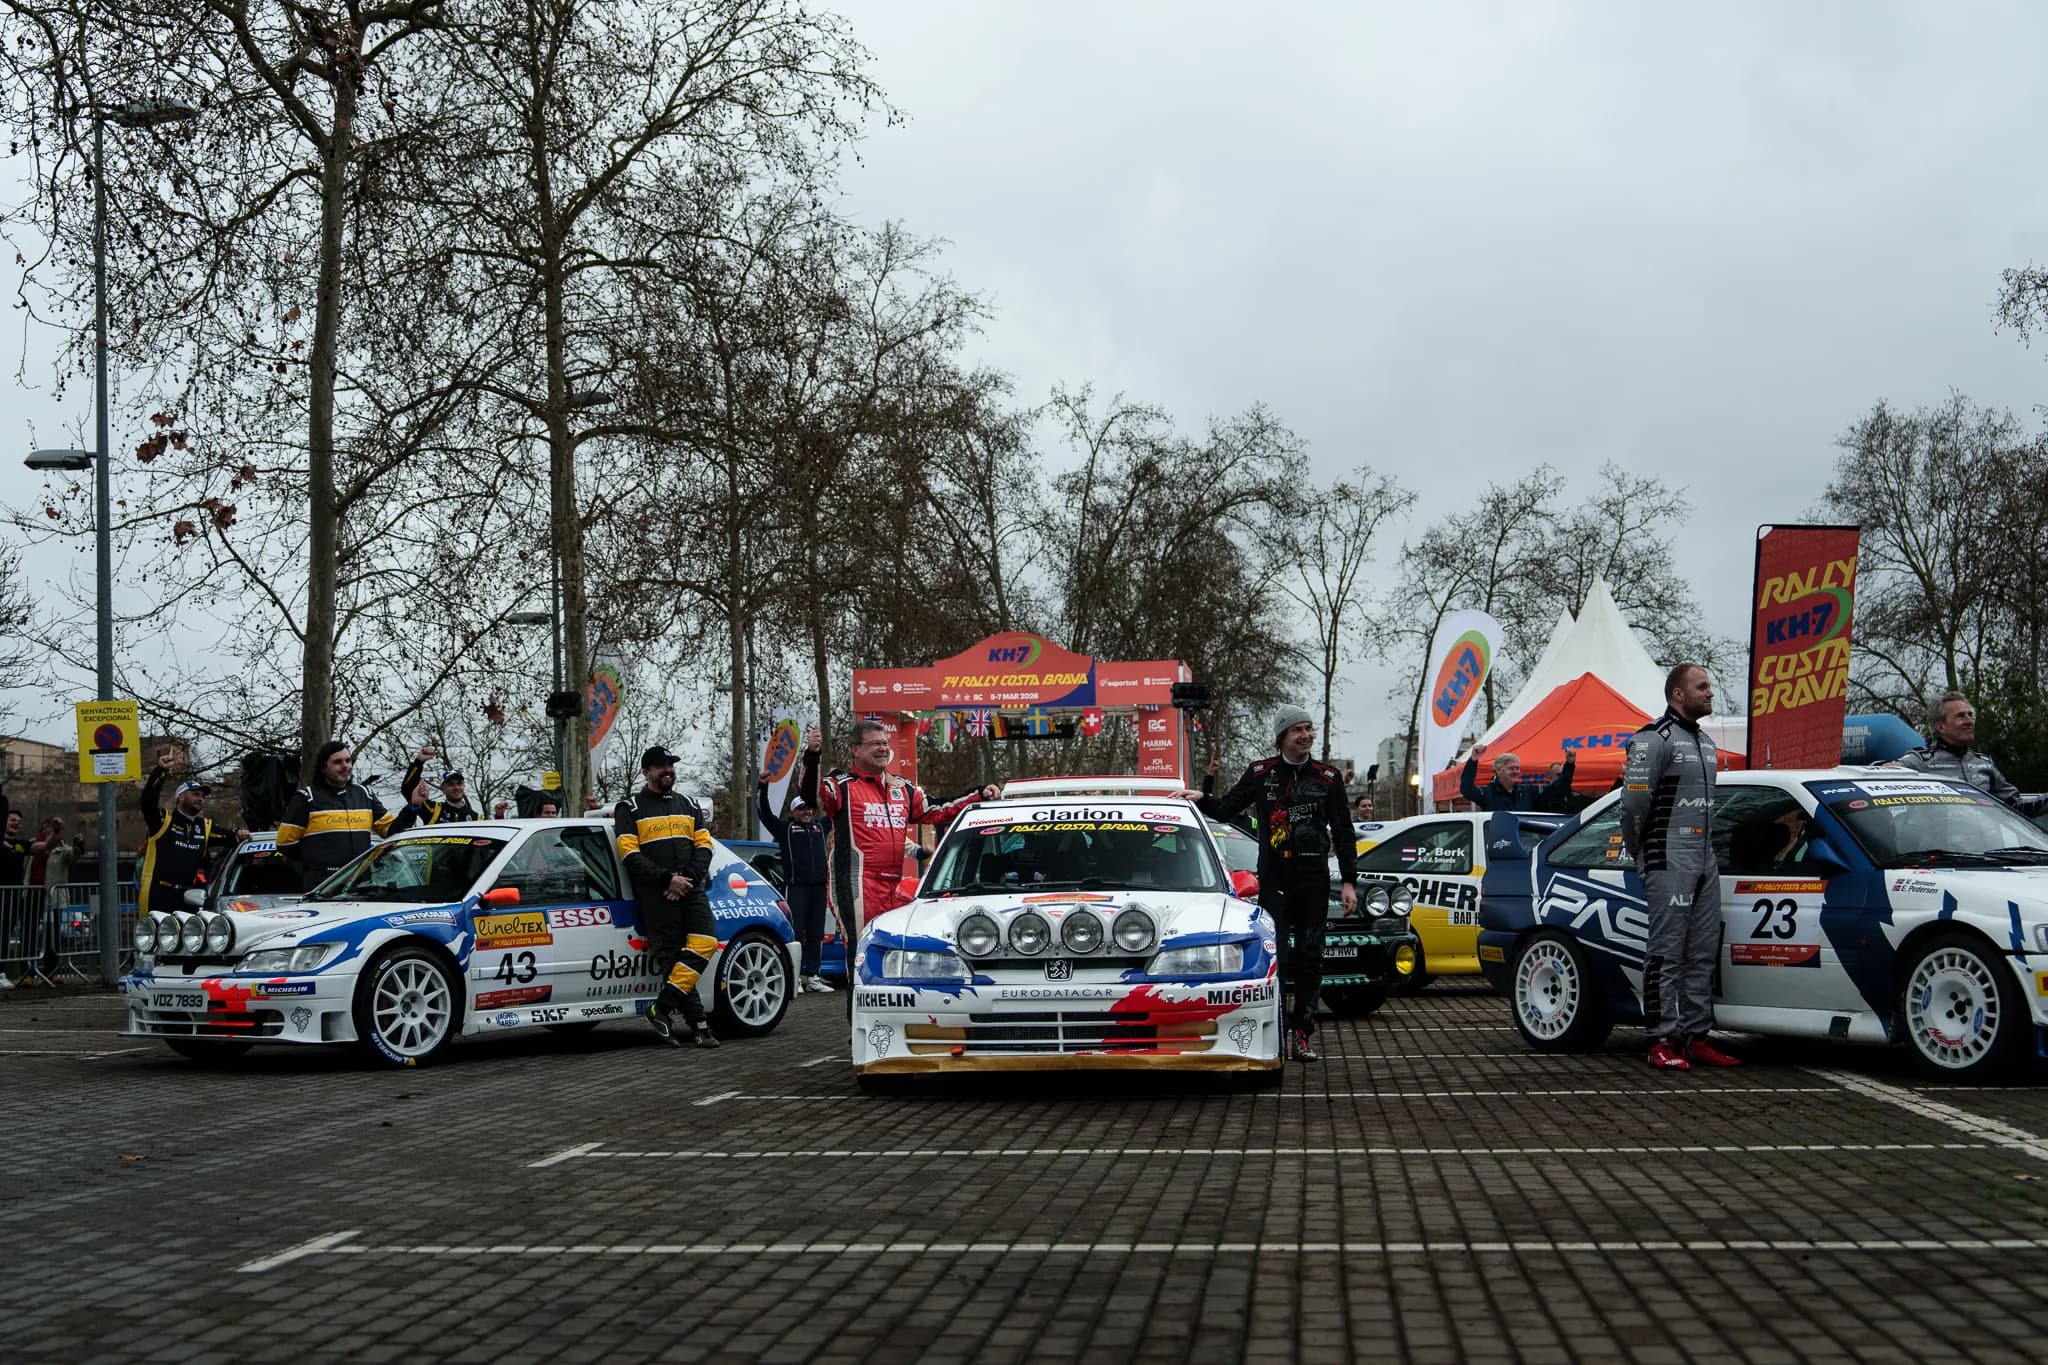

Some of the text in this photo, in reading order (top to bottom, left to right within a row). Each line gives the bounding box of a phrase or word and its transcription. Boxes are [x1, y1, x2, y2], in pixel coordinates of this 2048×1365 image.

[1759, 556, 1857, 609] RALLY
[1758, 636, 1850, 685] COSTA
[942, 673, 1089, 688] 74 RALLY COSTA BRAVA
[1002, 693, 1020, 701] MAR
[1752, 667, 1849, 717] BRAVA
[1872, 797, 1907, 806] RALLY
[1907, 796, 1939, 804] COSTA
[1032, 808, 1123, 821] clarion
[864, 816, 906, 828] TYRES
[1008, 823, 1149, 833] RALLY COSTA BRAVA
[1418, 847, 1465, 856] P. Berk
[1908, 885, 1938, 894] Pedersen
[550, 907, 611, 928] ESSO
[714, 906, 769, 920] PEUGEOT
[1454, 912, 1472, 924] BAD
[1750, 898, 1798, 939] 23
[494, 951, 538, 985] 43
[267, 986, 308, 994] MICHELIN
[587, 986, 603, 997] CAR
[607, 984, 632, 995] AUDIO
[1001, 989, 1113, 998] EURODATACAR
[1208, 986, 1274, 1004] MICHELIN
[152, 994, 203, 1008] VDZ 7833
[857, 993, 916, 1007] MICHELIN
[531, 1008, 569, 1023] SKF
[581, 1004, 623, 1018] speedline
